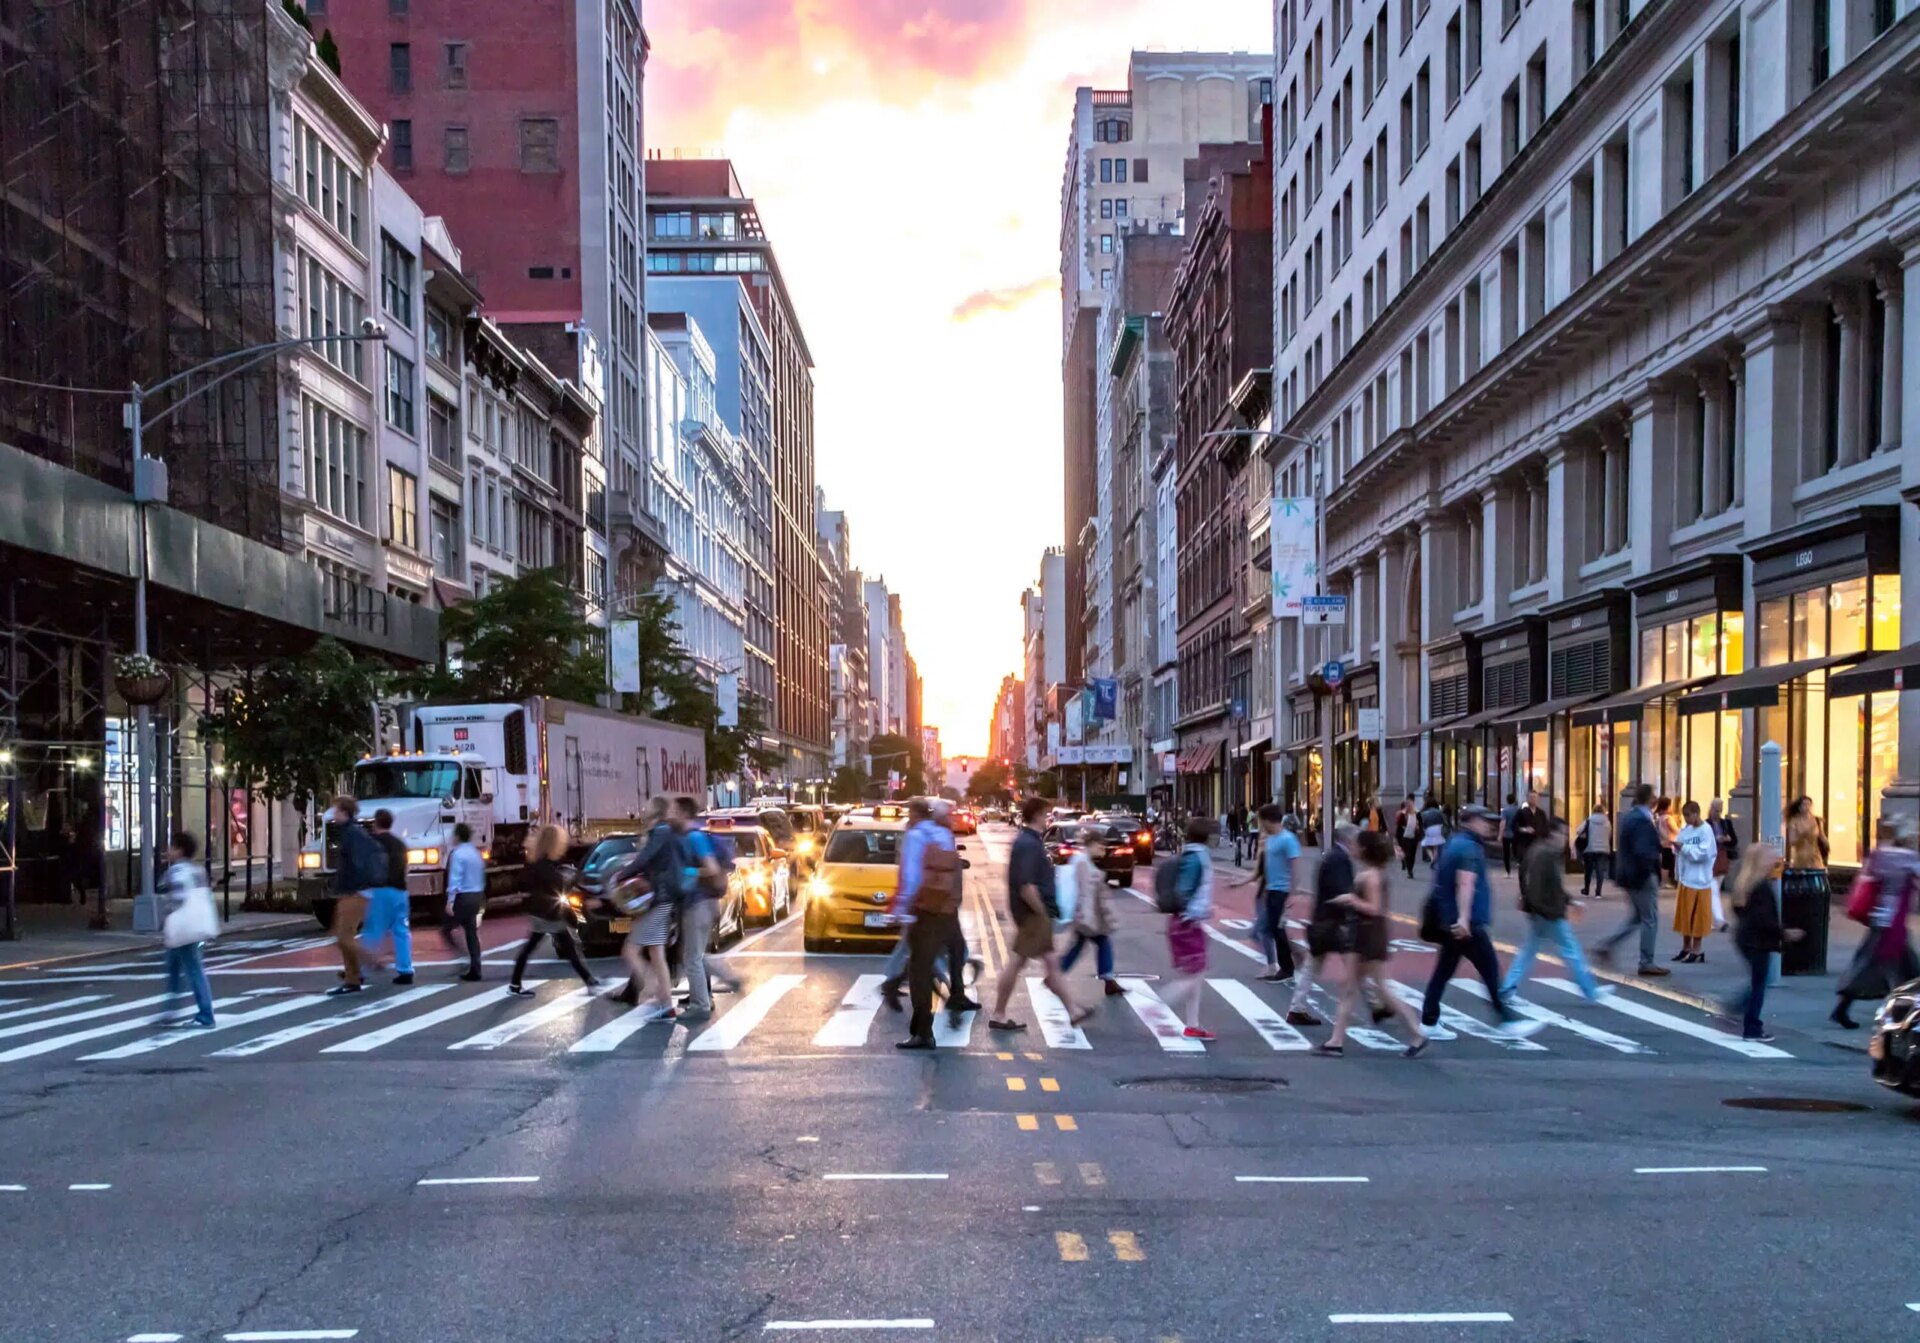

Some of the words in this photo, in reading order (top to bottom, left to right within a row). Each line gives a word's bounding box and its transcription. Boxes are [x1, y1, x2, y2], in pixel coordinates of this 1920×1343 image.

[1796, 551, 1813, 567] LEGO
[1666, 589, 1679, 603] LEGO
[661, 747, 701, 794] Bartlett
